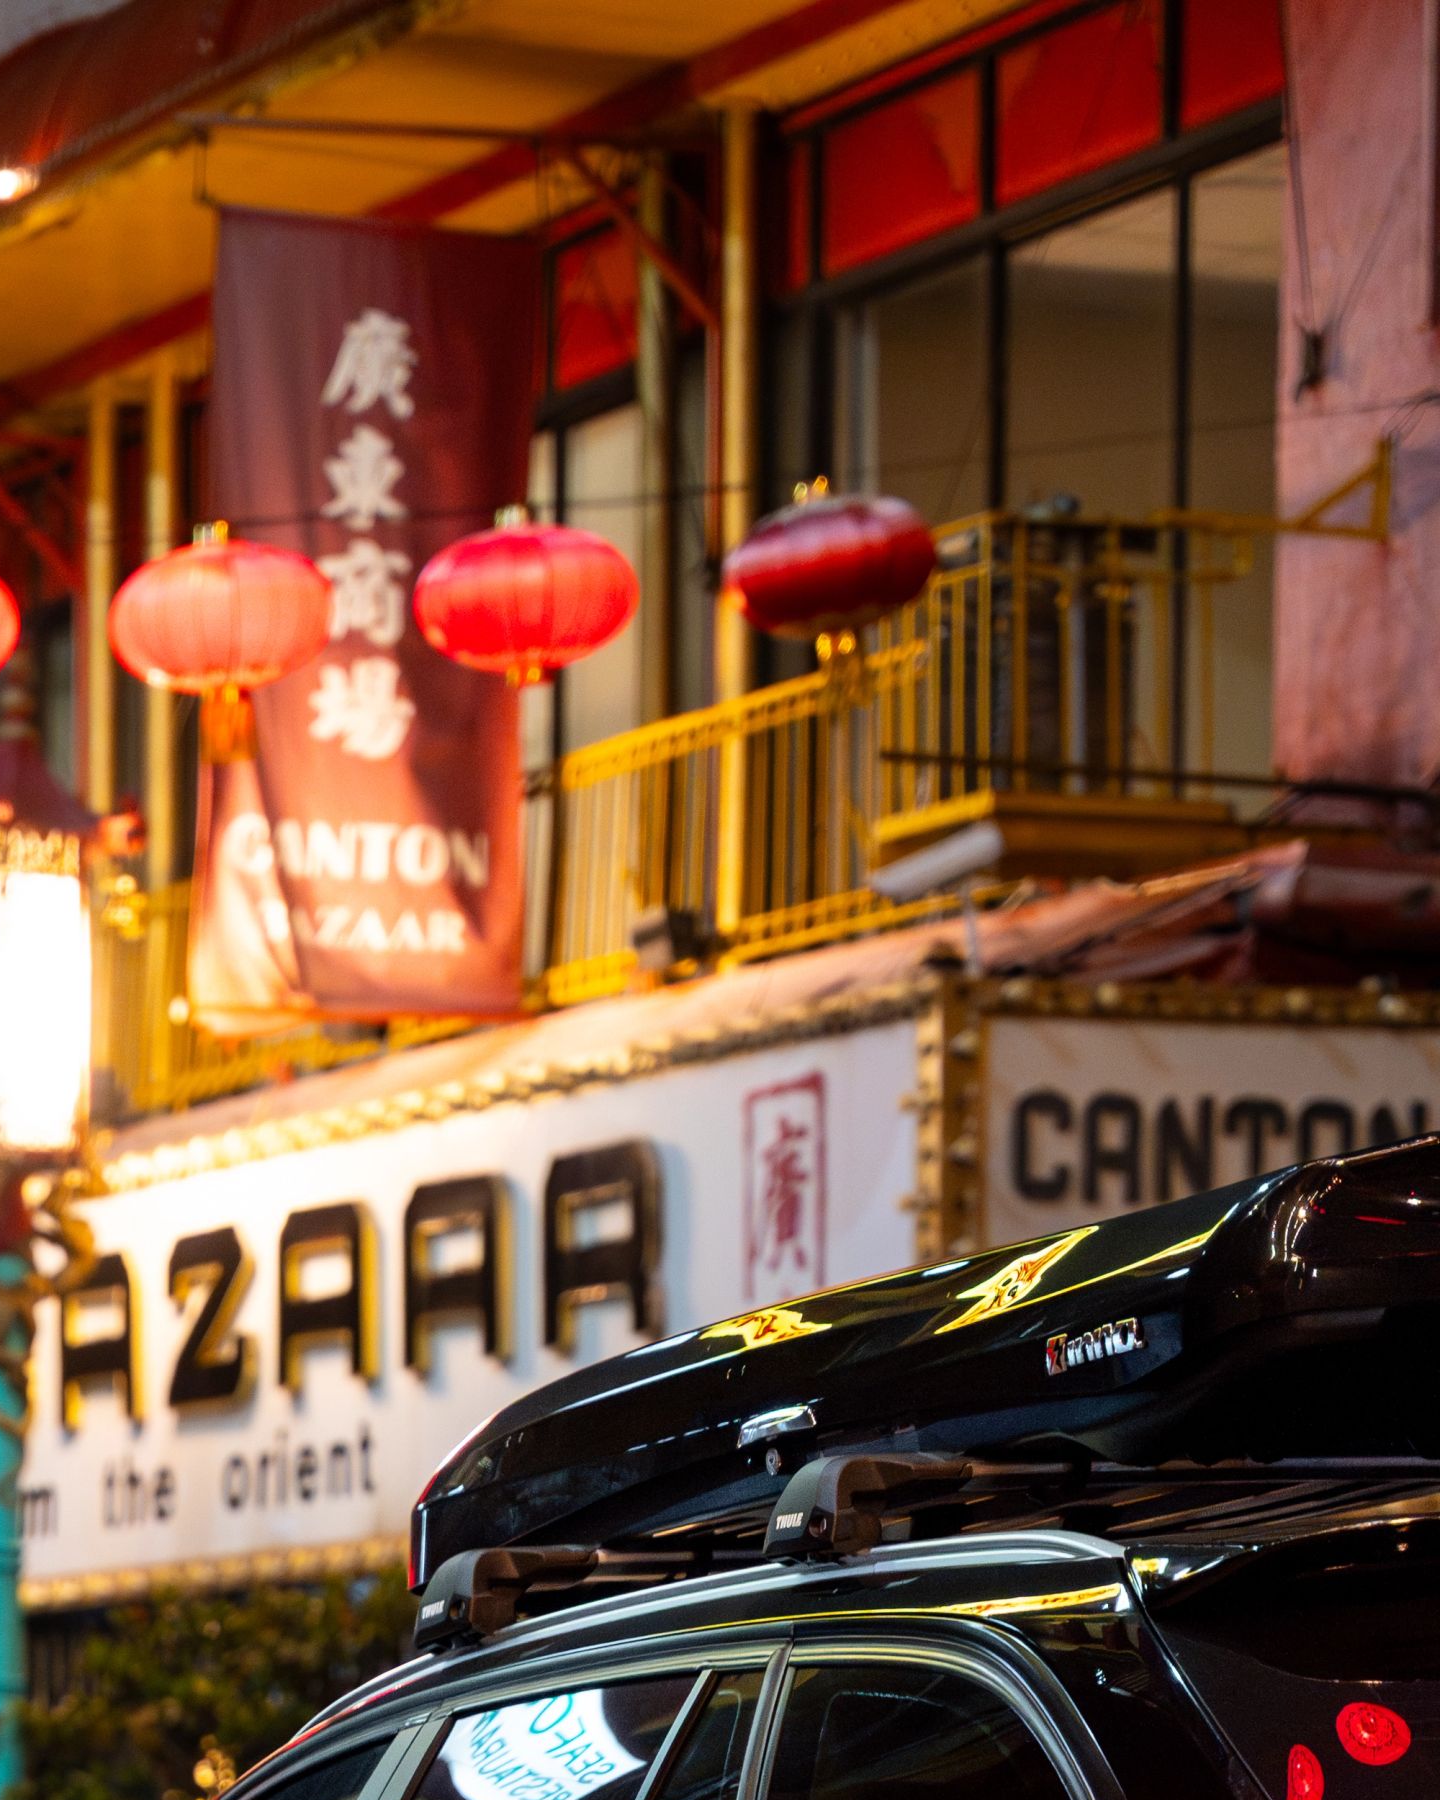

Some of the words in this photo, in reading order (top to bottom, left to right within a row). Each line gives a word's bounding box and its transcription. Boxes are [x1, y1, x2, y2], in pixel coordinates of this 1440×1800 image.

[103, 1456, 176, 1528] the
[222, 1425, 377, 1512] orient
[775, 1511, 804, 1530] THULE
